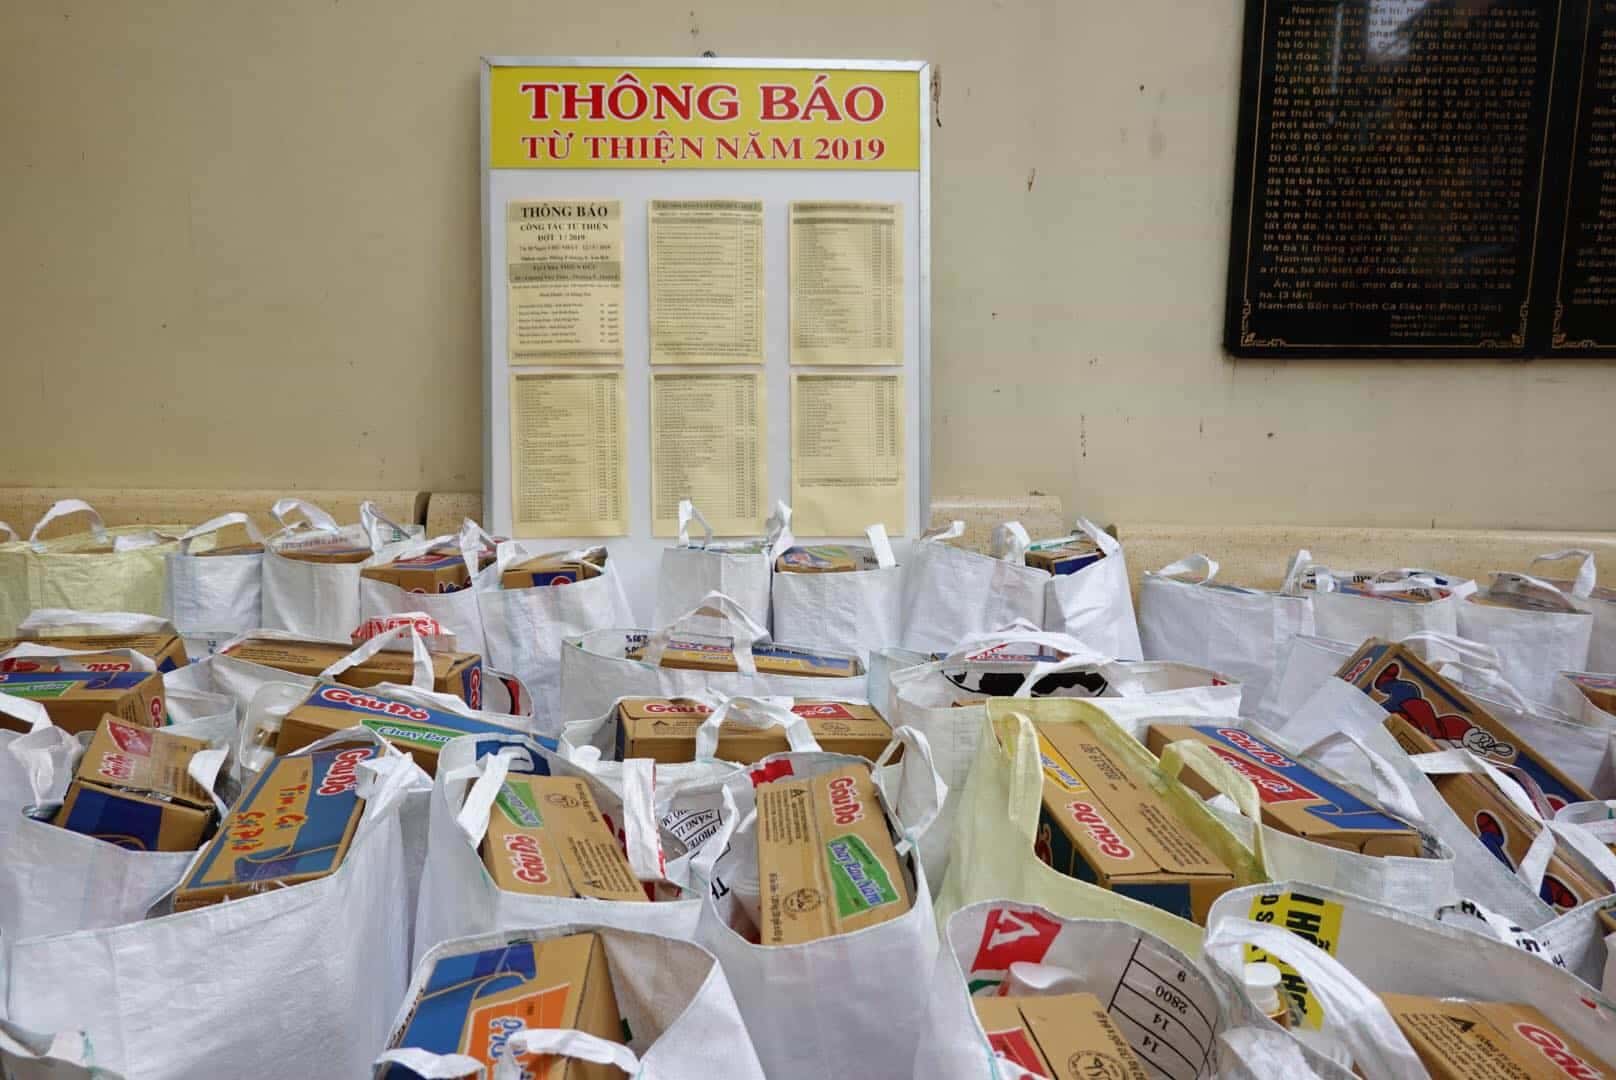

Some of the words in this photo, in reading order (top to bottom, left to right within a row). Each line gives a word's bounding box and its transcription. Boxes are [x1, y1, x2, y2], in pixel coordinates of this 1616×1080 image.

[521, 74, 739, 121] THÔNG
[761, 76, 885, 122] BÁO
[522, 132, 574, 161] TỪ
[585, 131, 703, 163] THIỆN
[717, 132, 802, 161] NĂM
[815, 138, 885, 161] 2019
[1155, 985, 1189, 1014] 2800
[1152, 1014, 1170, 1032] 14
[1142, 1035, 1160, 1054] 14
